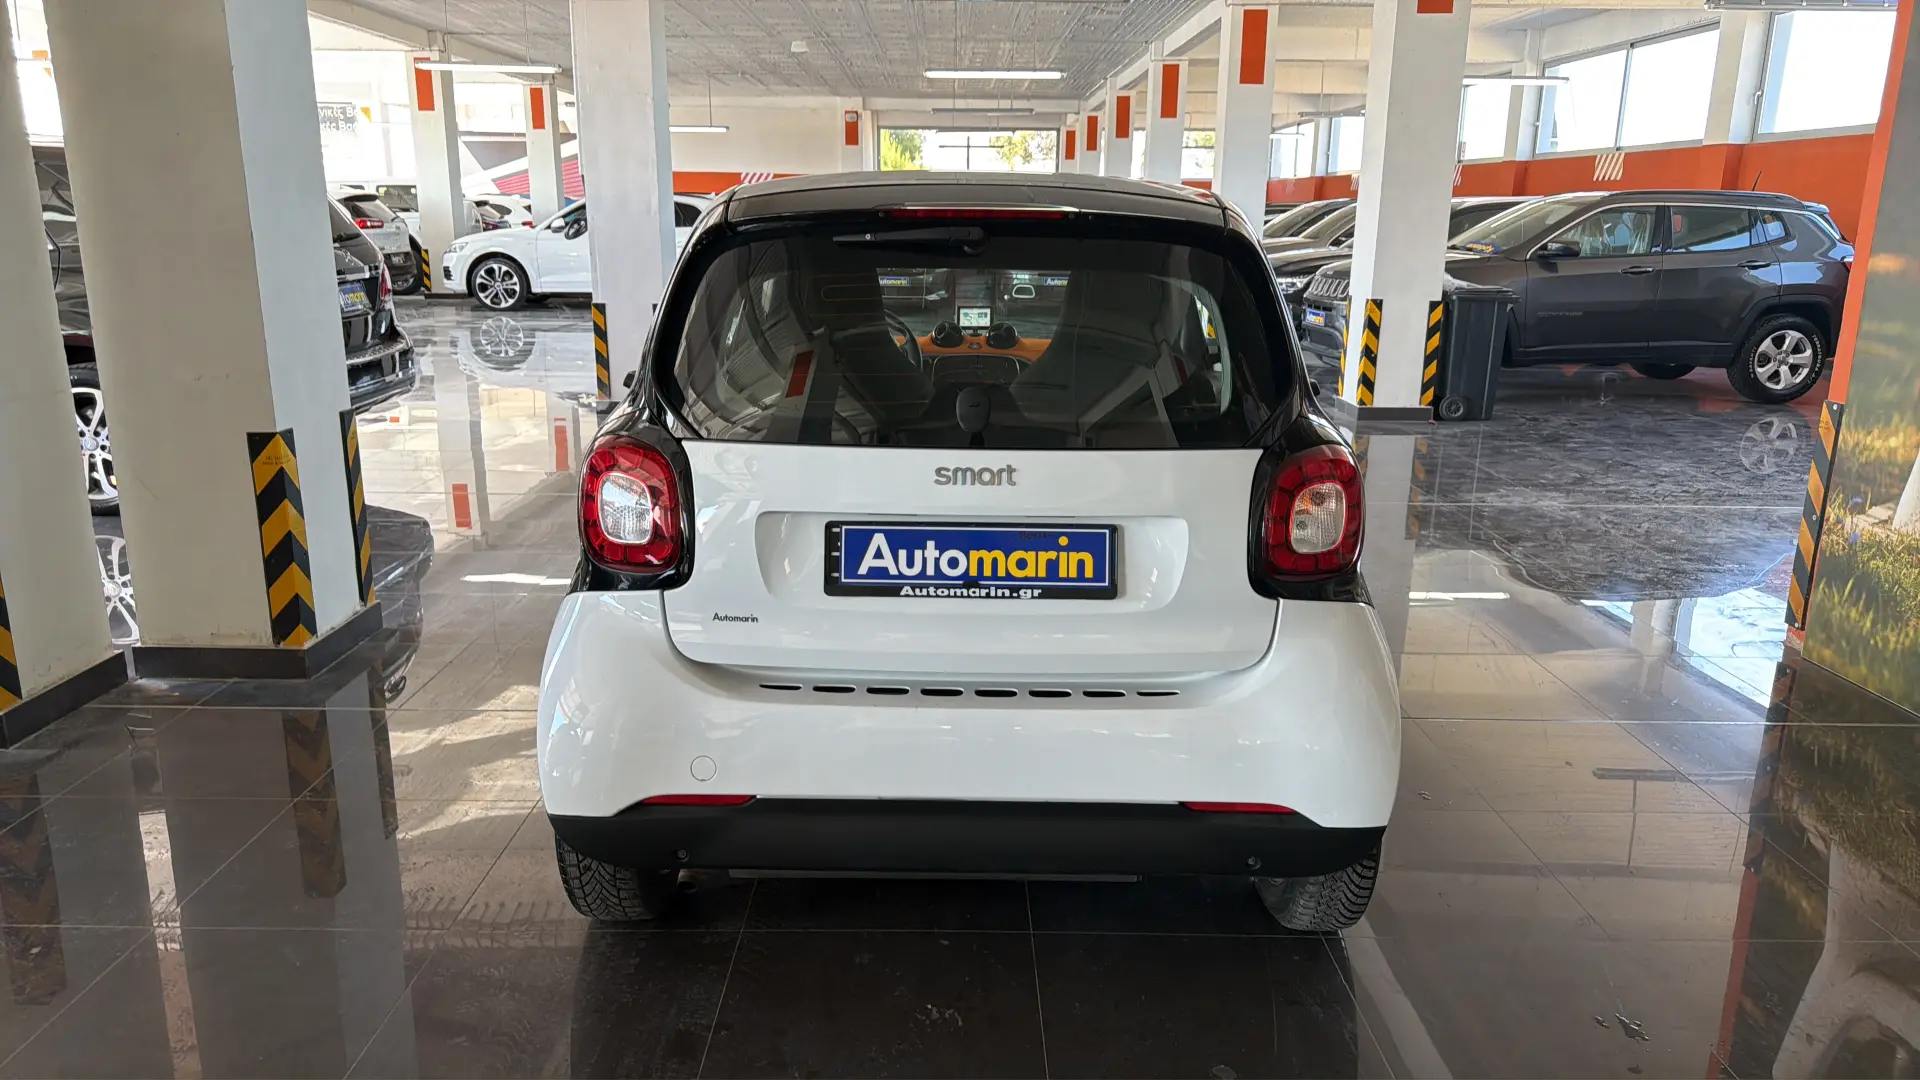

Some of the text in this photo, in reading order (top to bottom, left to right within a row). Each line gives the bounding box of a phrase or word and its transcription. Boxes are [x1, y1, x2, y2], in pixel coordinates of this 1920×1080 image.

[934, 464, 1017, 486] smart
[857, 532, 1094, 578] Automarin
[900, 585, 1042, 598] Automarin.gr
[712, 612, 759, 623] Automarin
